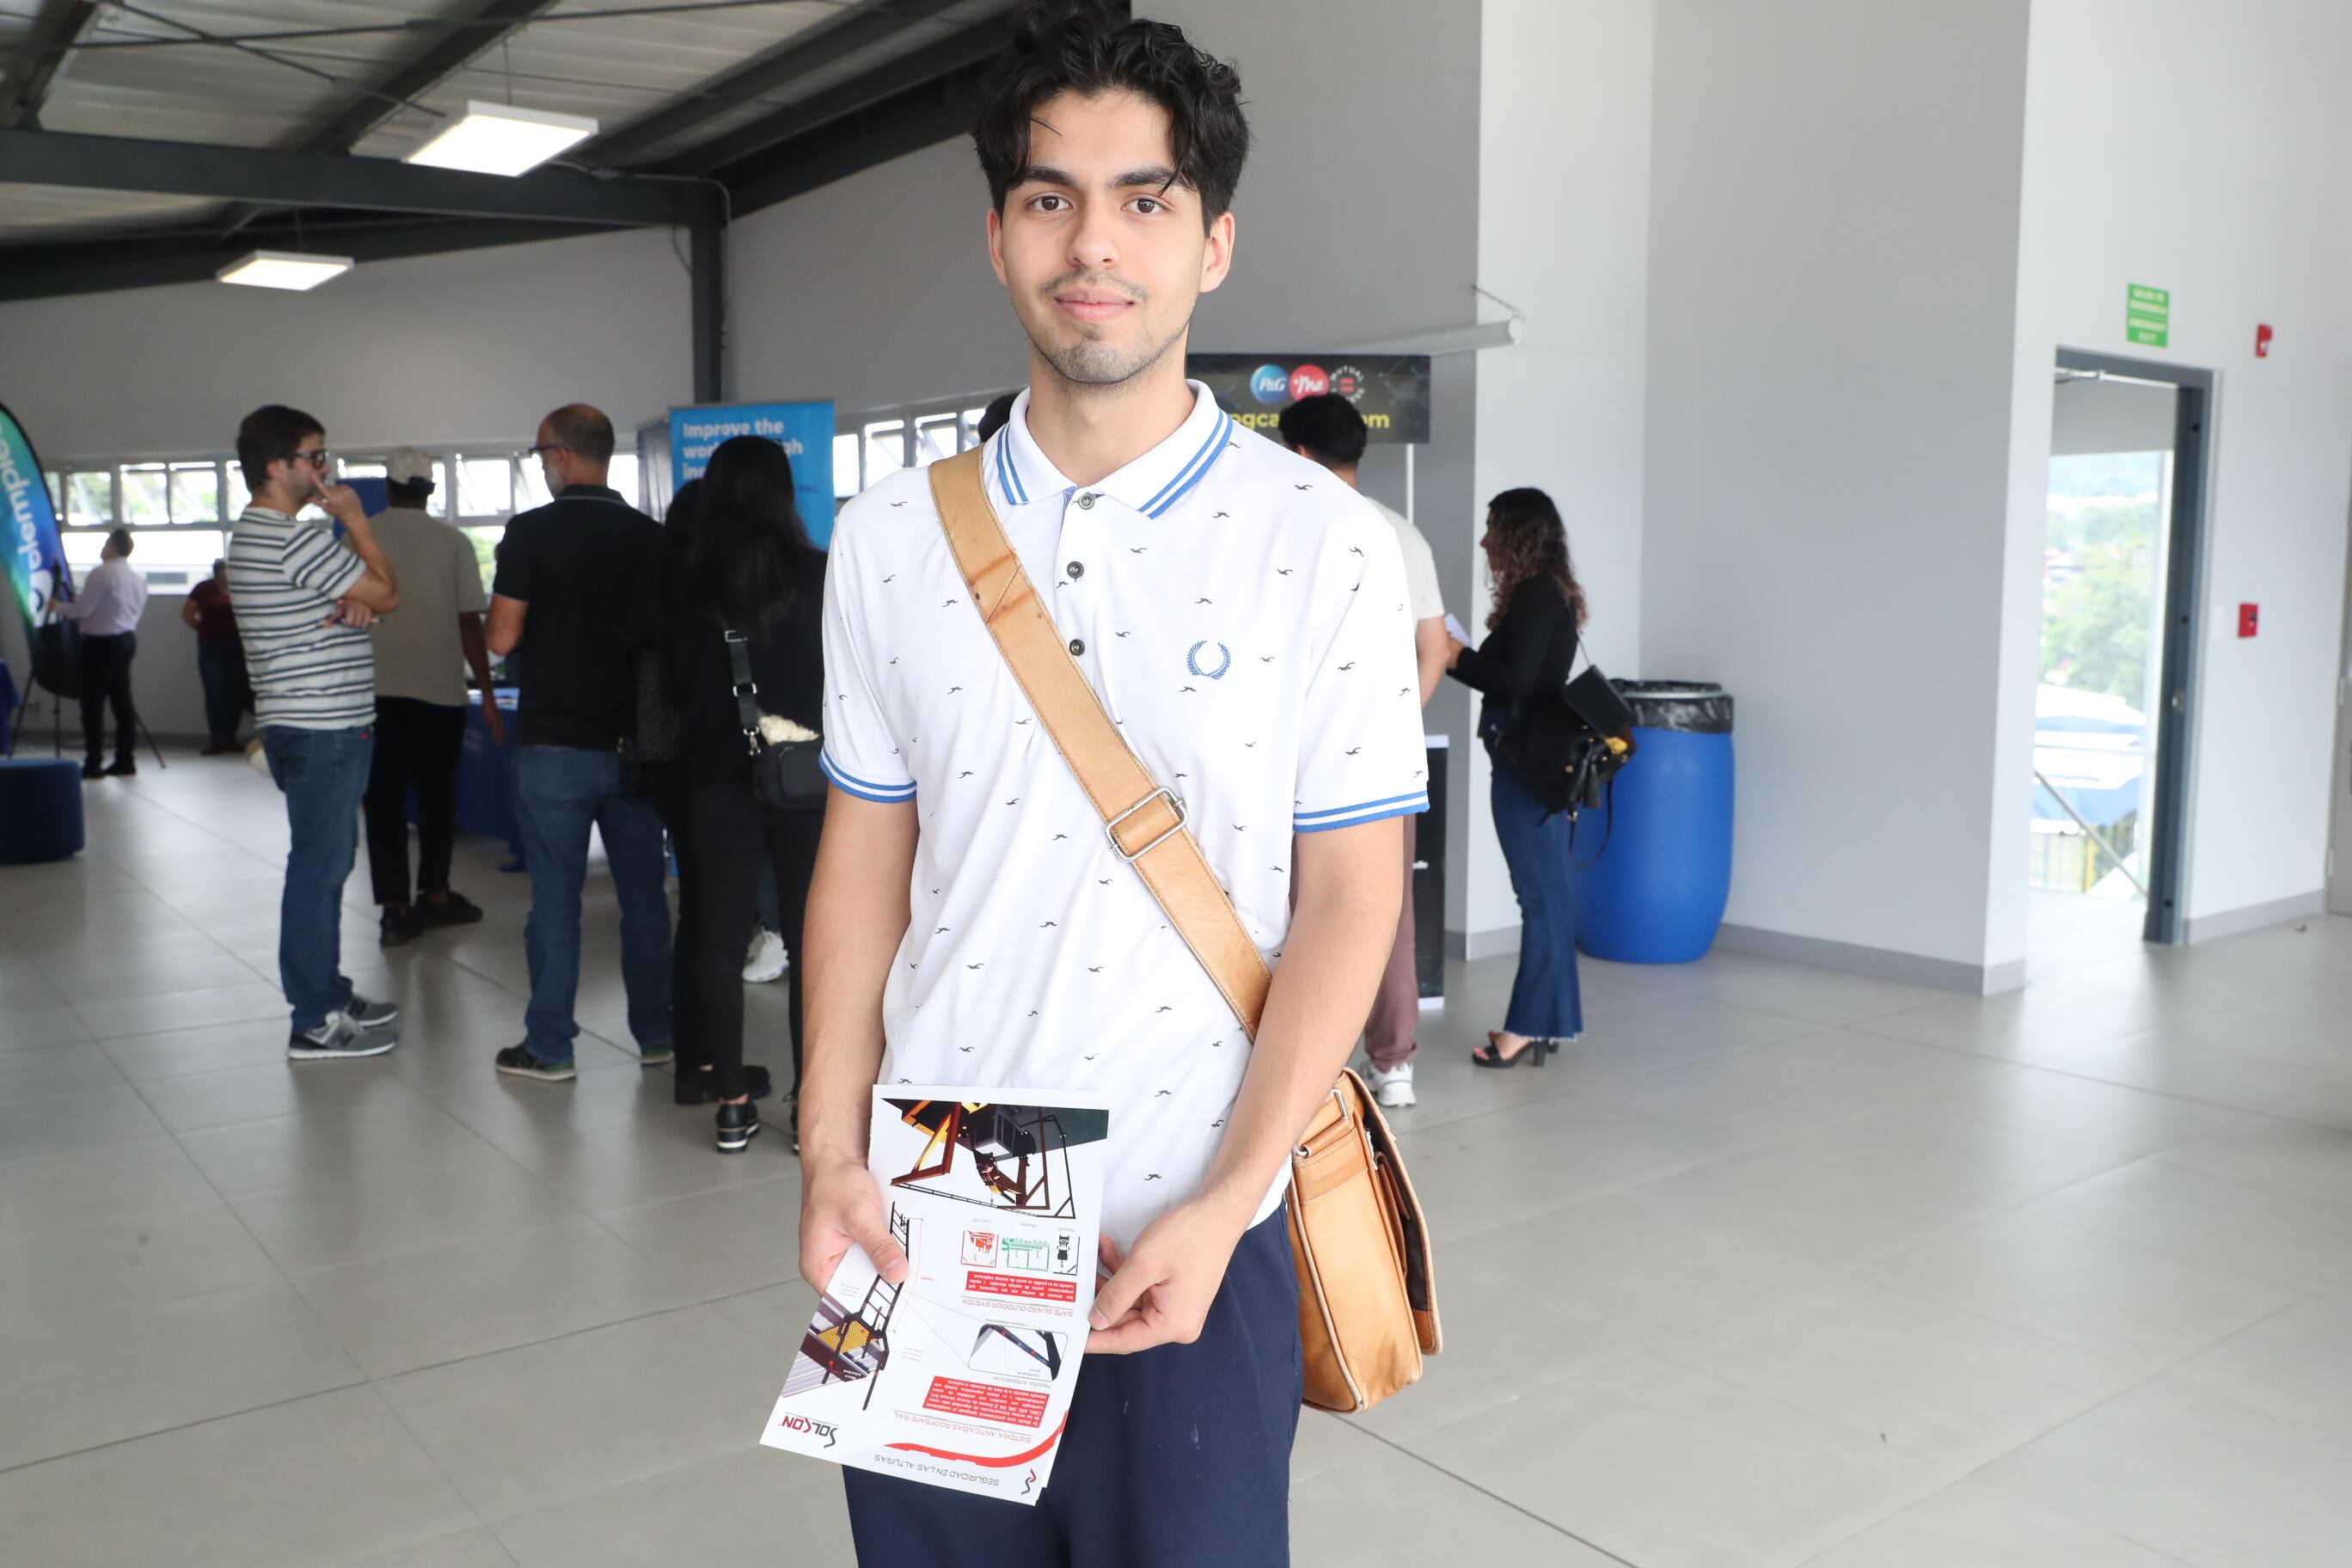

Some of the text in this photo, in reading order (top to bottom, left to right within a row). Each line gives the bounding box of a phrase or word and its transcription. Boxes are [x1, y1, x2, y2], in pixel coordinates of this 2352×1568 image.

[683, 418, 784, 440] Improve the
[961, 1298, 990, 1307] SYSTEM
[892, 1412, 910, 1420] RAIL
[997, 1431, 1032, 1443] SISTEMA
[873, 1453, 999, 1486] SEGURIDAD EN LAS ALTURAS
